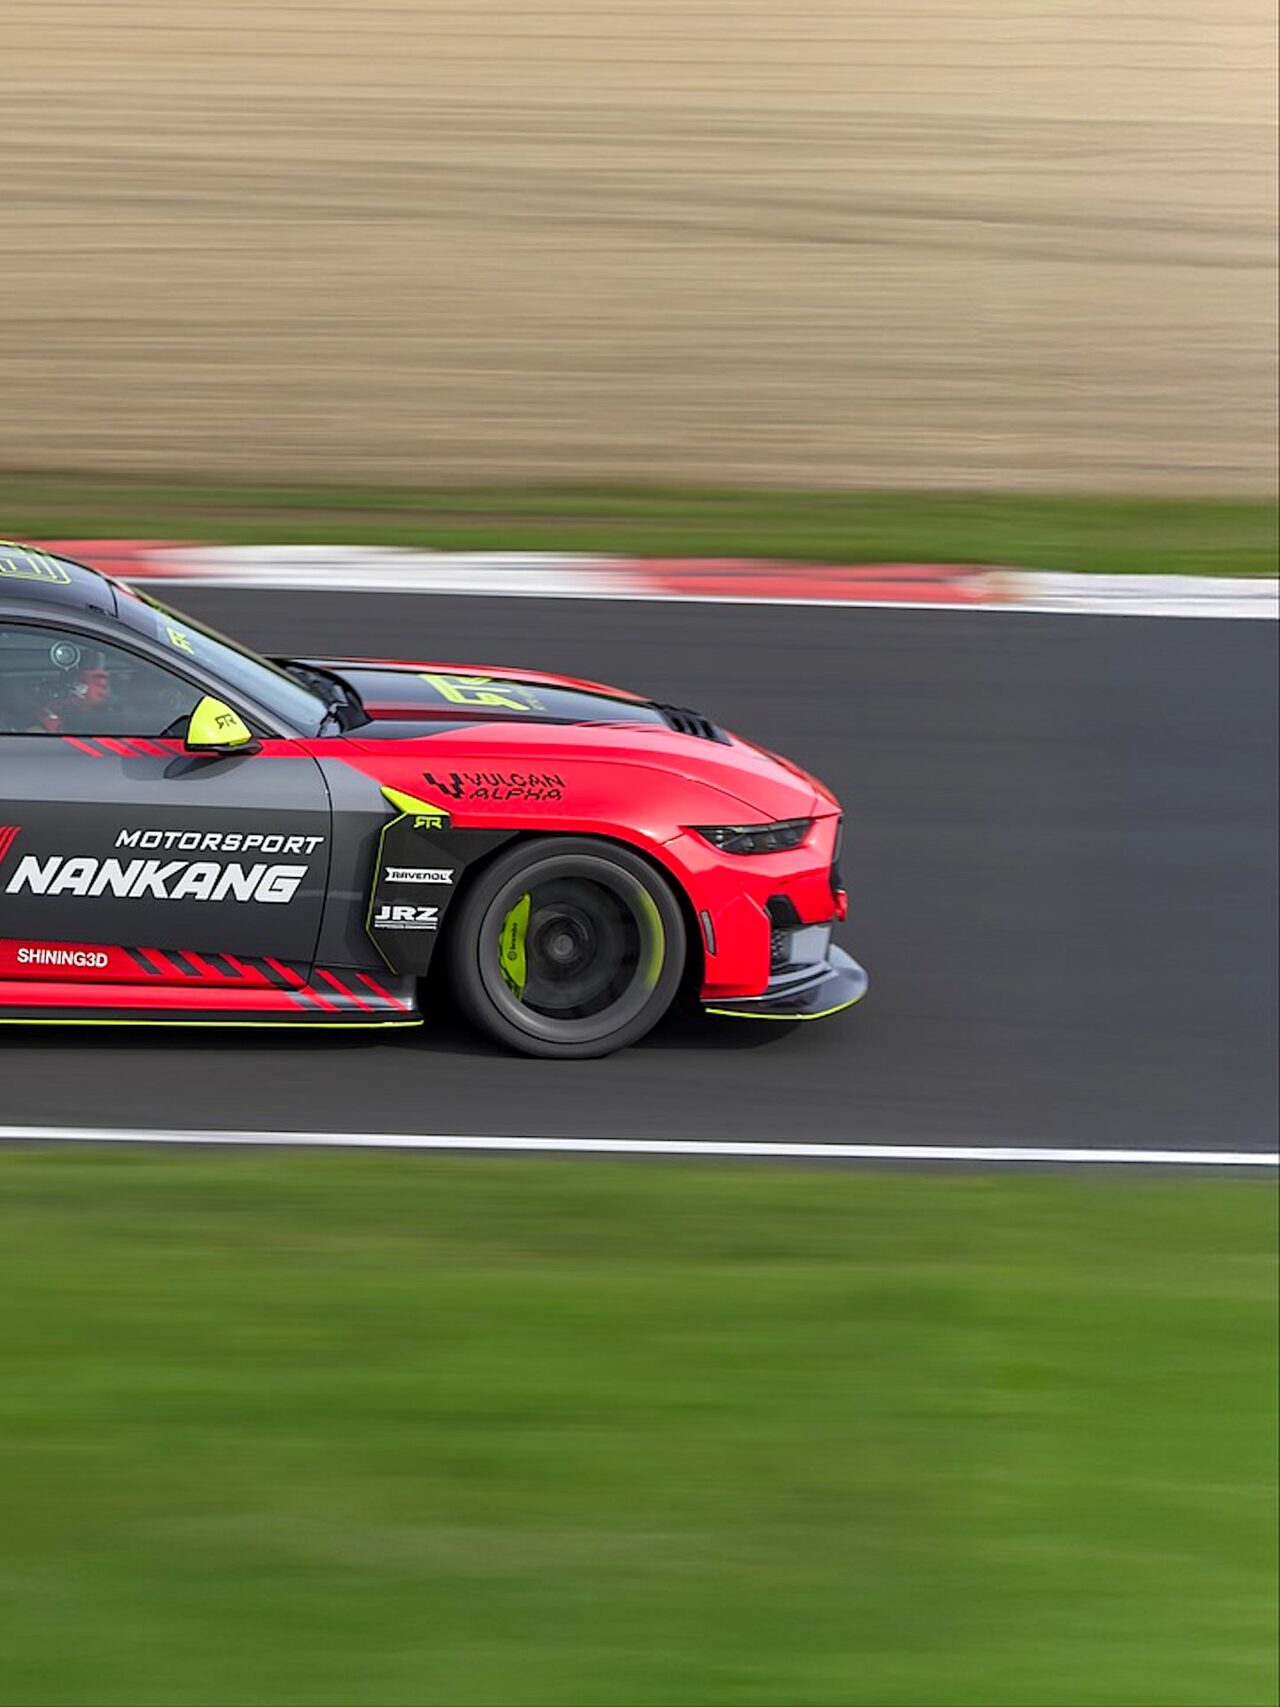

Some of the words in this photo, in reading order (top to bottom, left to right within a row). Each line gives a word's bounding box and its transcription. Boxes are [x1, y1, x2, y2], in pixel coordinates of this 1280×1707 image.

[463, 772, 566, 788] VULCAN
[469, 786, 563, 801] ALPHA
[115, 829, 325, 855] MOTORSPORT
[4, 855, 309, 903] NANKANG
[374, 905, 439, 922] JRZ
[17, 947, 109, 968] SHINING3D
